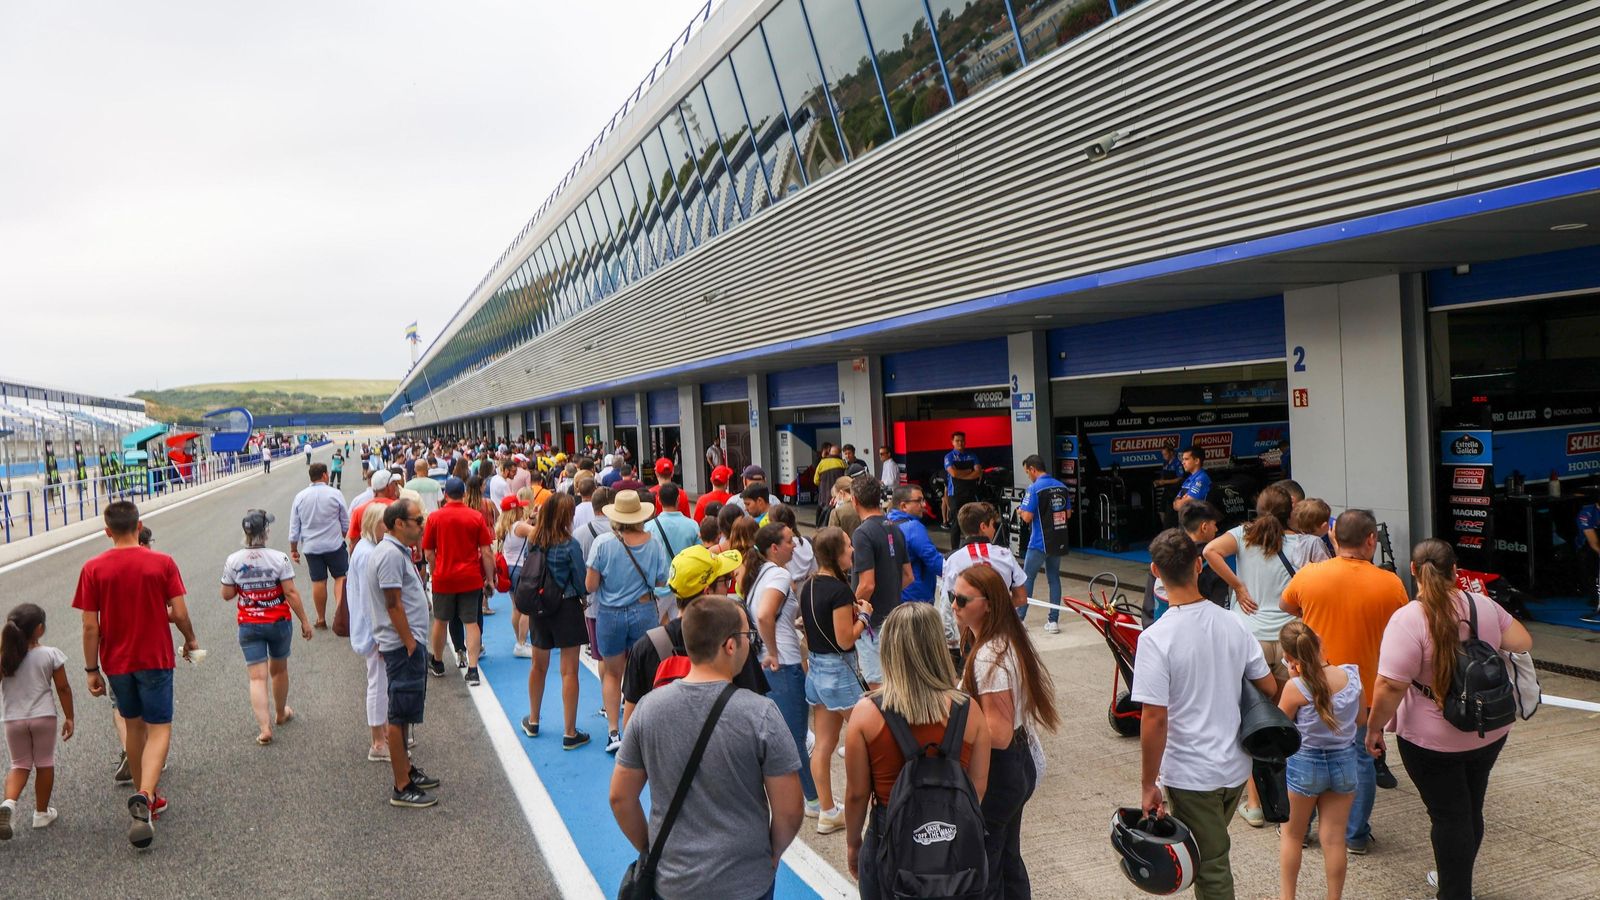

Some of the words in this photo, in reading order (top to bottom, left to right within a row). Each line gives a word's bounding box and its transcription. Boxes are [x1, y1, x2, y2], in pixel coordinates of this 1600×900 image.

[1293, 346, 1306, 372] 2
[1011, 374, 1019, 393] 3
[973, 391, 1004, 402] CARDOSO
[1021, 393, 1032, 401] NO
[1507, 409, 1537, 421] GALFER
[1117, 417, 1142, 426] GALFER
[1114, 437, 1166, 451] SCALEXTRIC
[1200, 434, 1230, 445] MONLAU
[1254, 440, 1280, 448] RACIN
[1455, 440, 1479, 448] Estrella
[1571, 434, 1600, 451] SCALE
[1122, 453, 1157, 463] HONDA
[1204, 447, 1226, 459] OTUL
[1568, 459, 1600, 471] HOND
[1453, 508, 1488, 518] MAGURO
